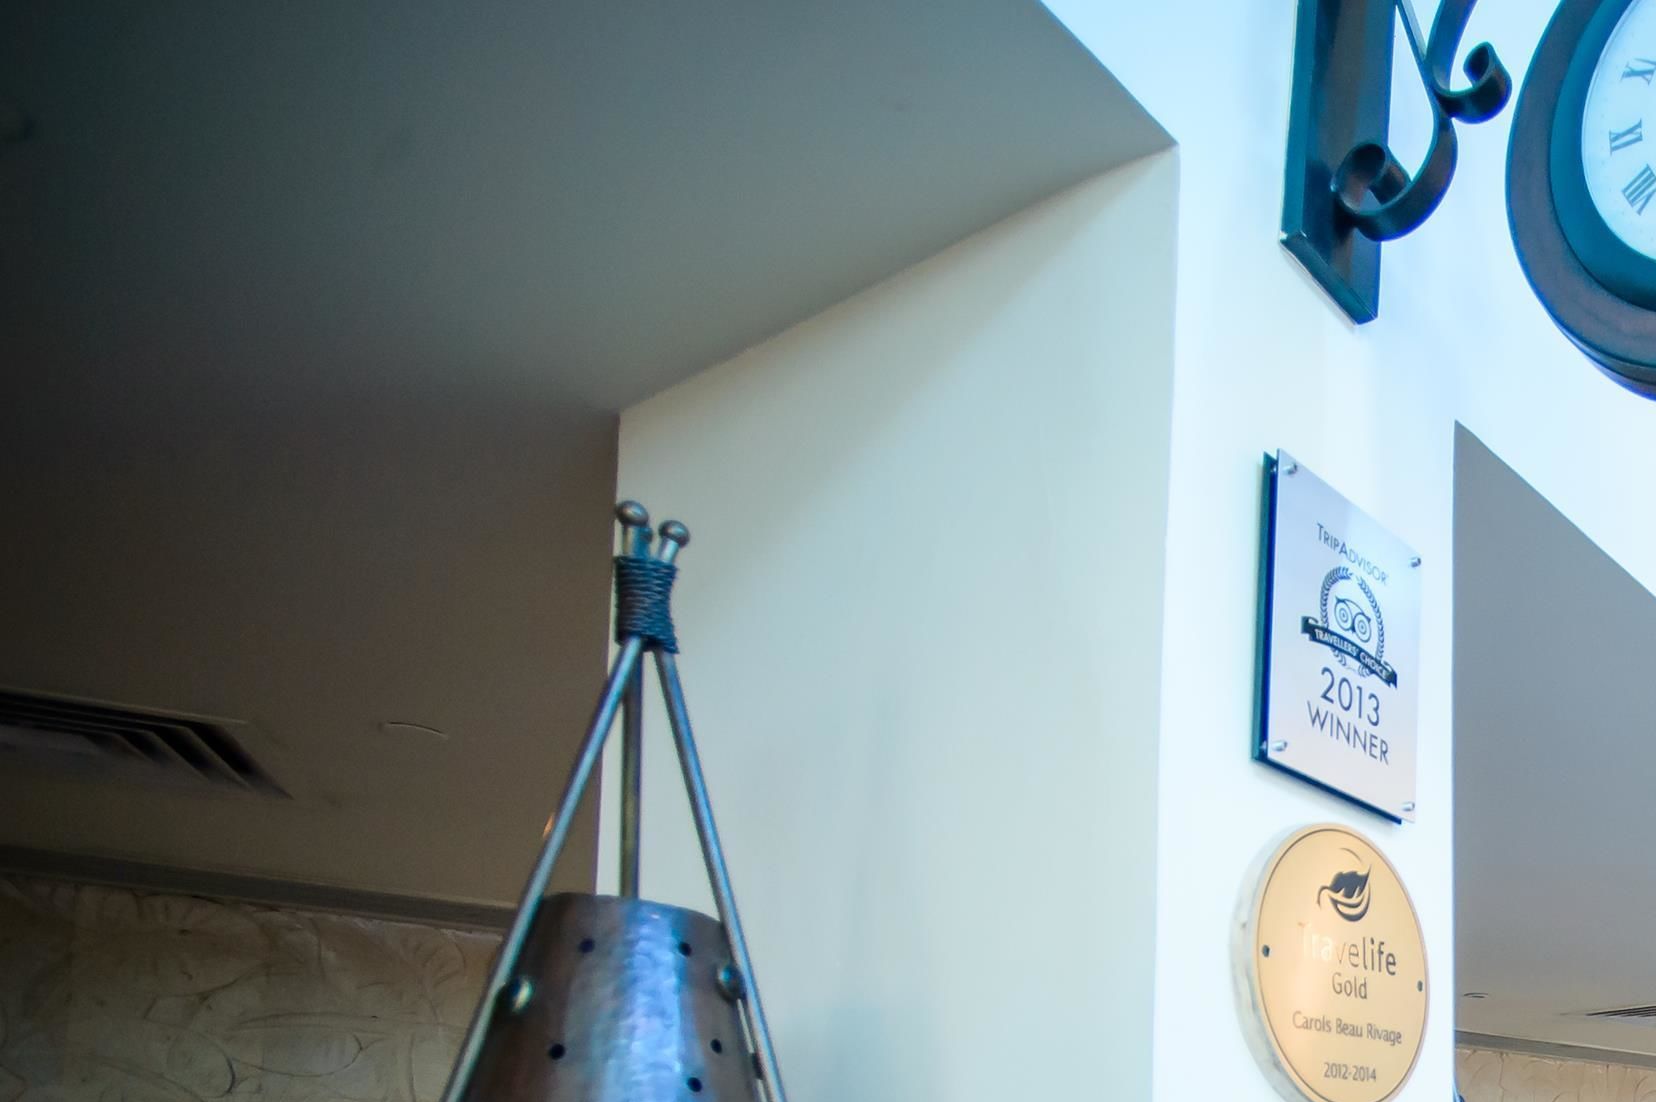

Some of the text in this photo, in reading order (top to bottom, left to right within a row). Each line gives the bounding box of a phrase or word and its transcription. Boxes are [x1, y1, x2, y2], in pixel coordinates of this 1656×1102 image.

[1620, 62, 1656, 86] X
[1609, 118, 1643, 156] IX
[1360, 651, 1388, 680] CHOICE
[1320, 666, 1380, 727] 2013
[1307, 700, 1389, 766] WINNER
[1332, 971, 1368, 999] Gold
[1292, 1010, 1402, 1046] Carols Beau Rivage
[1323, 1062, 1376, 1082] 2012-2014
